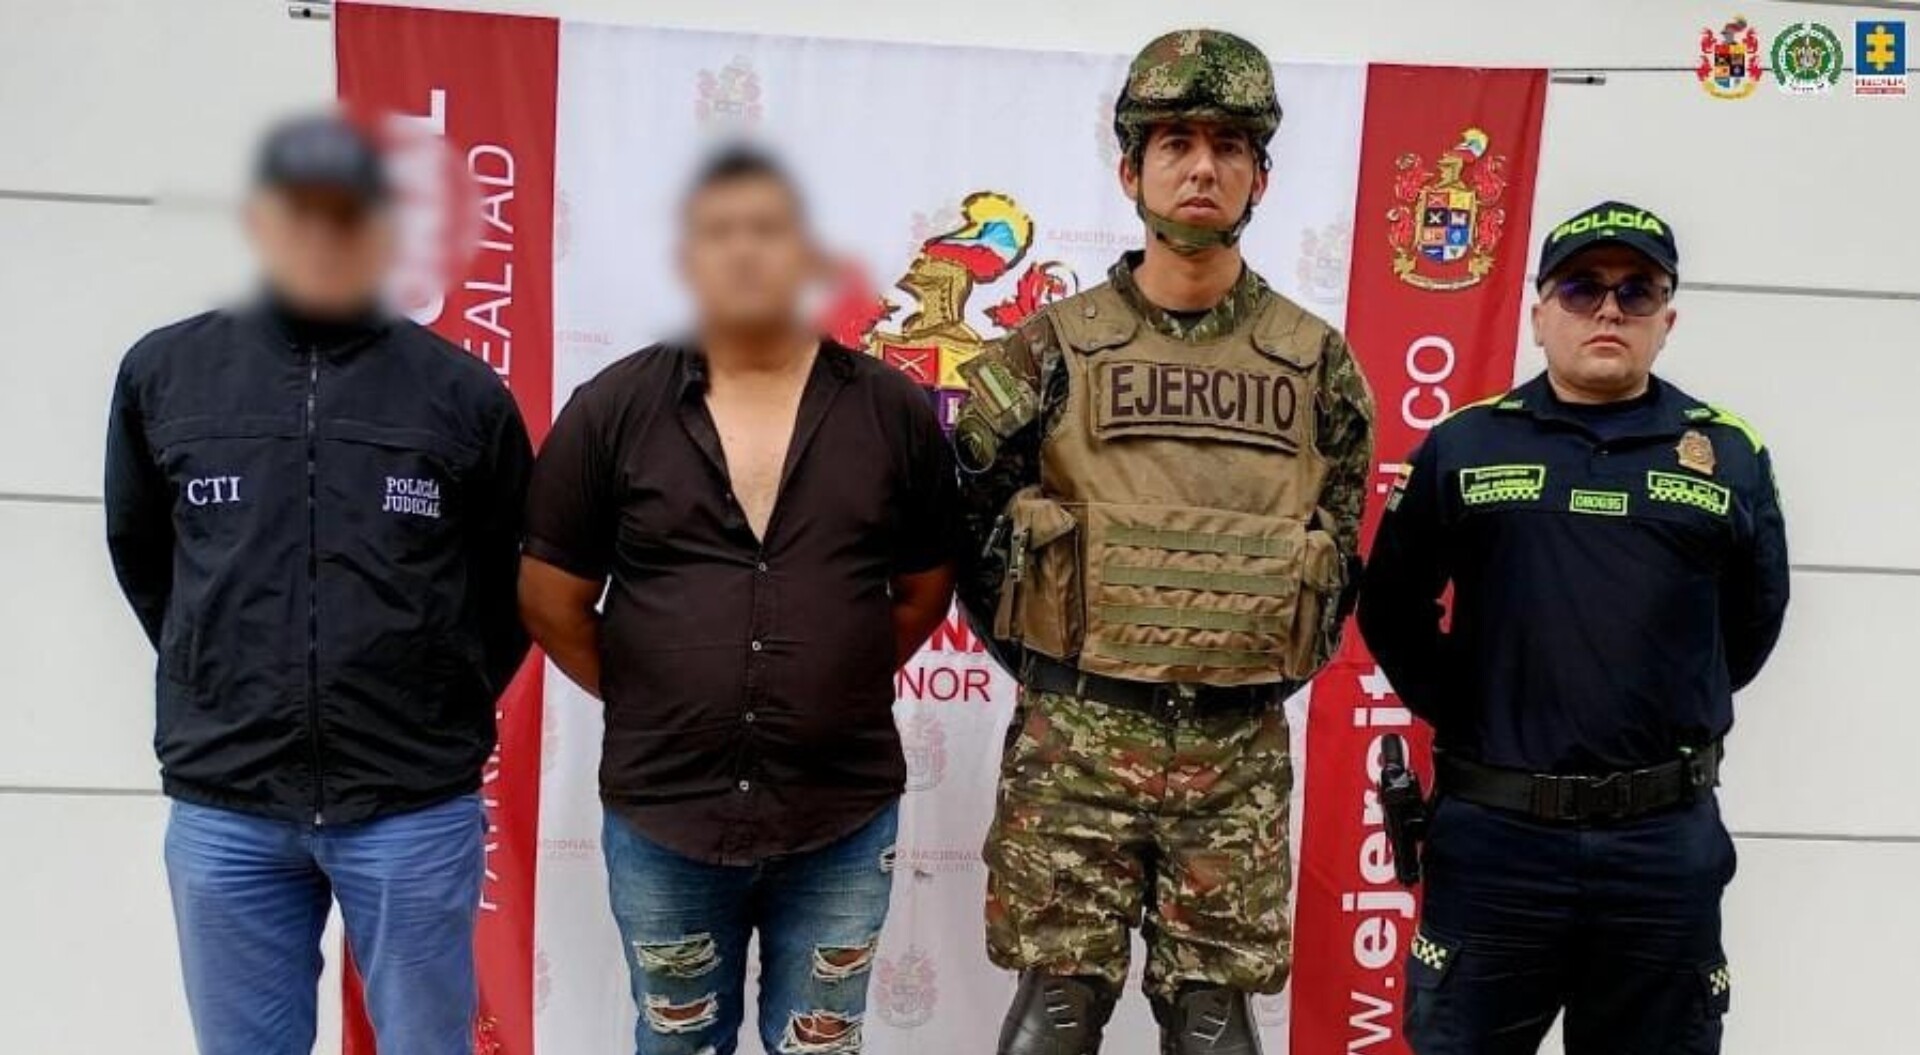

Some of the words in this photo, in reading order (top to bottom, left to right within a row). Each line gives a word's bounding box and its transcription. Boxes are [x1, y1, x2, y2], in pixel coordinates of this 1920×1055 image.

[464, 144, 514, 388] EALTAD
[1110, 365, 1297, 431] EJERCITO
[186, 476, 242, 506] CTI
[382, 495, 441, 518] JUDICIAL
